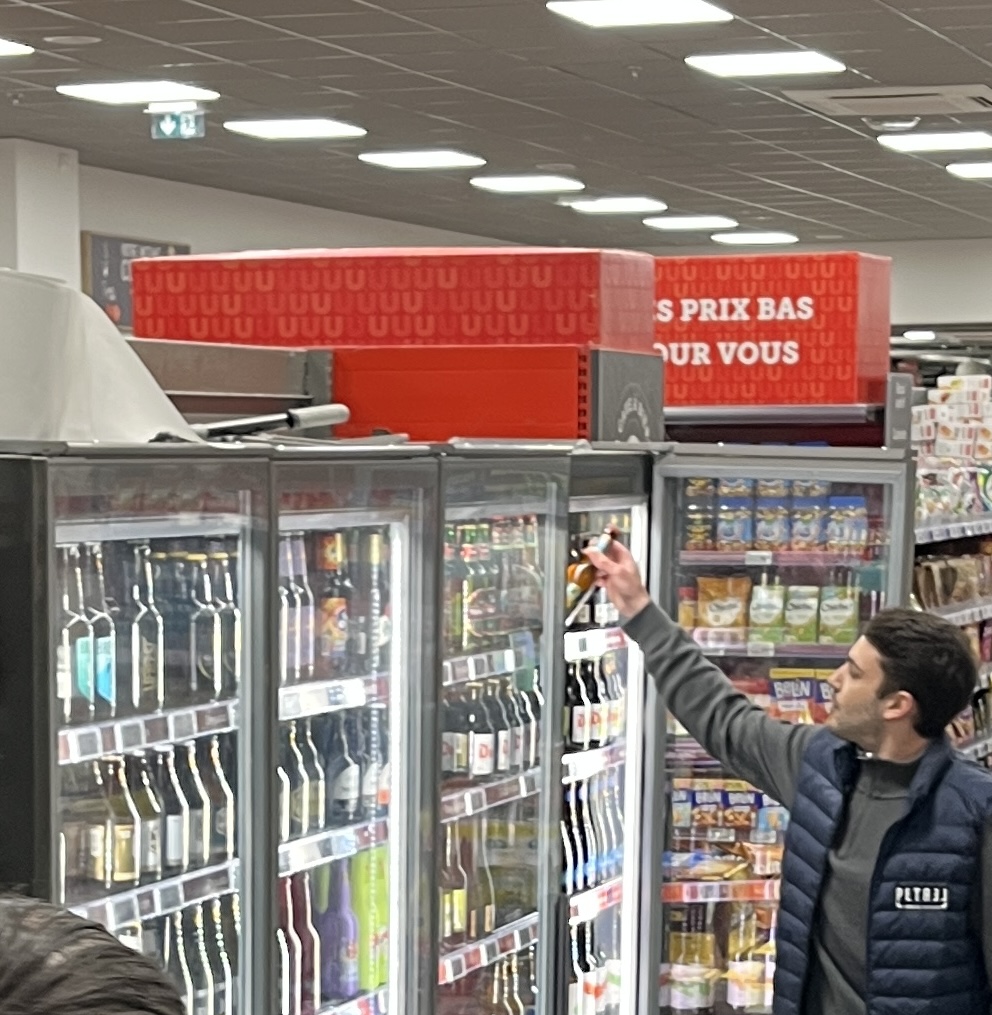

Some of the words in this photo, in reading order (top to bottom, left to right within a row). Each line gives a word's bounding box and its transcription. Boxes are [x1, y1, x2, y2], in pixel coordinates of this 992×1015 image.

[653, 298, 674, 323] S
[680, 297, 751, 323] PRIX
[757, 295, 814, 321] BAS
[717, 340, 800, 365] VOUS
